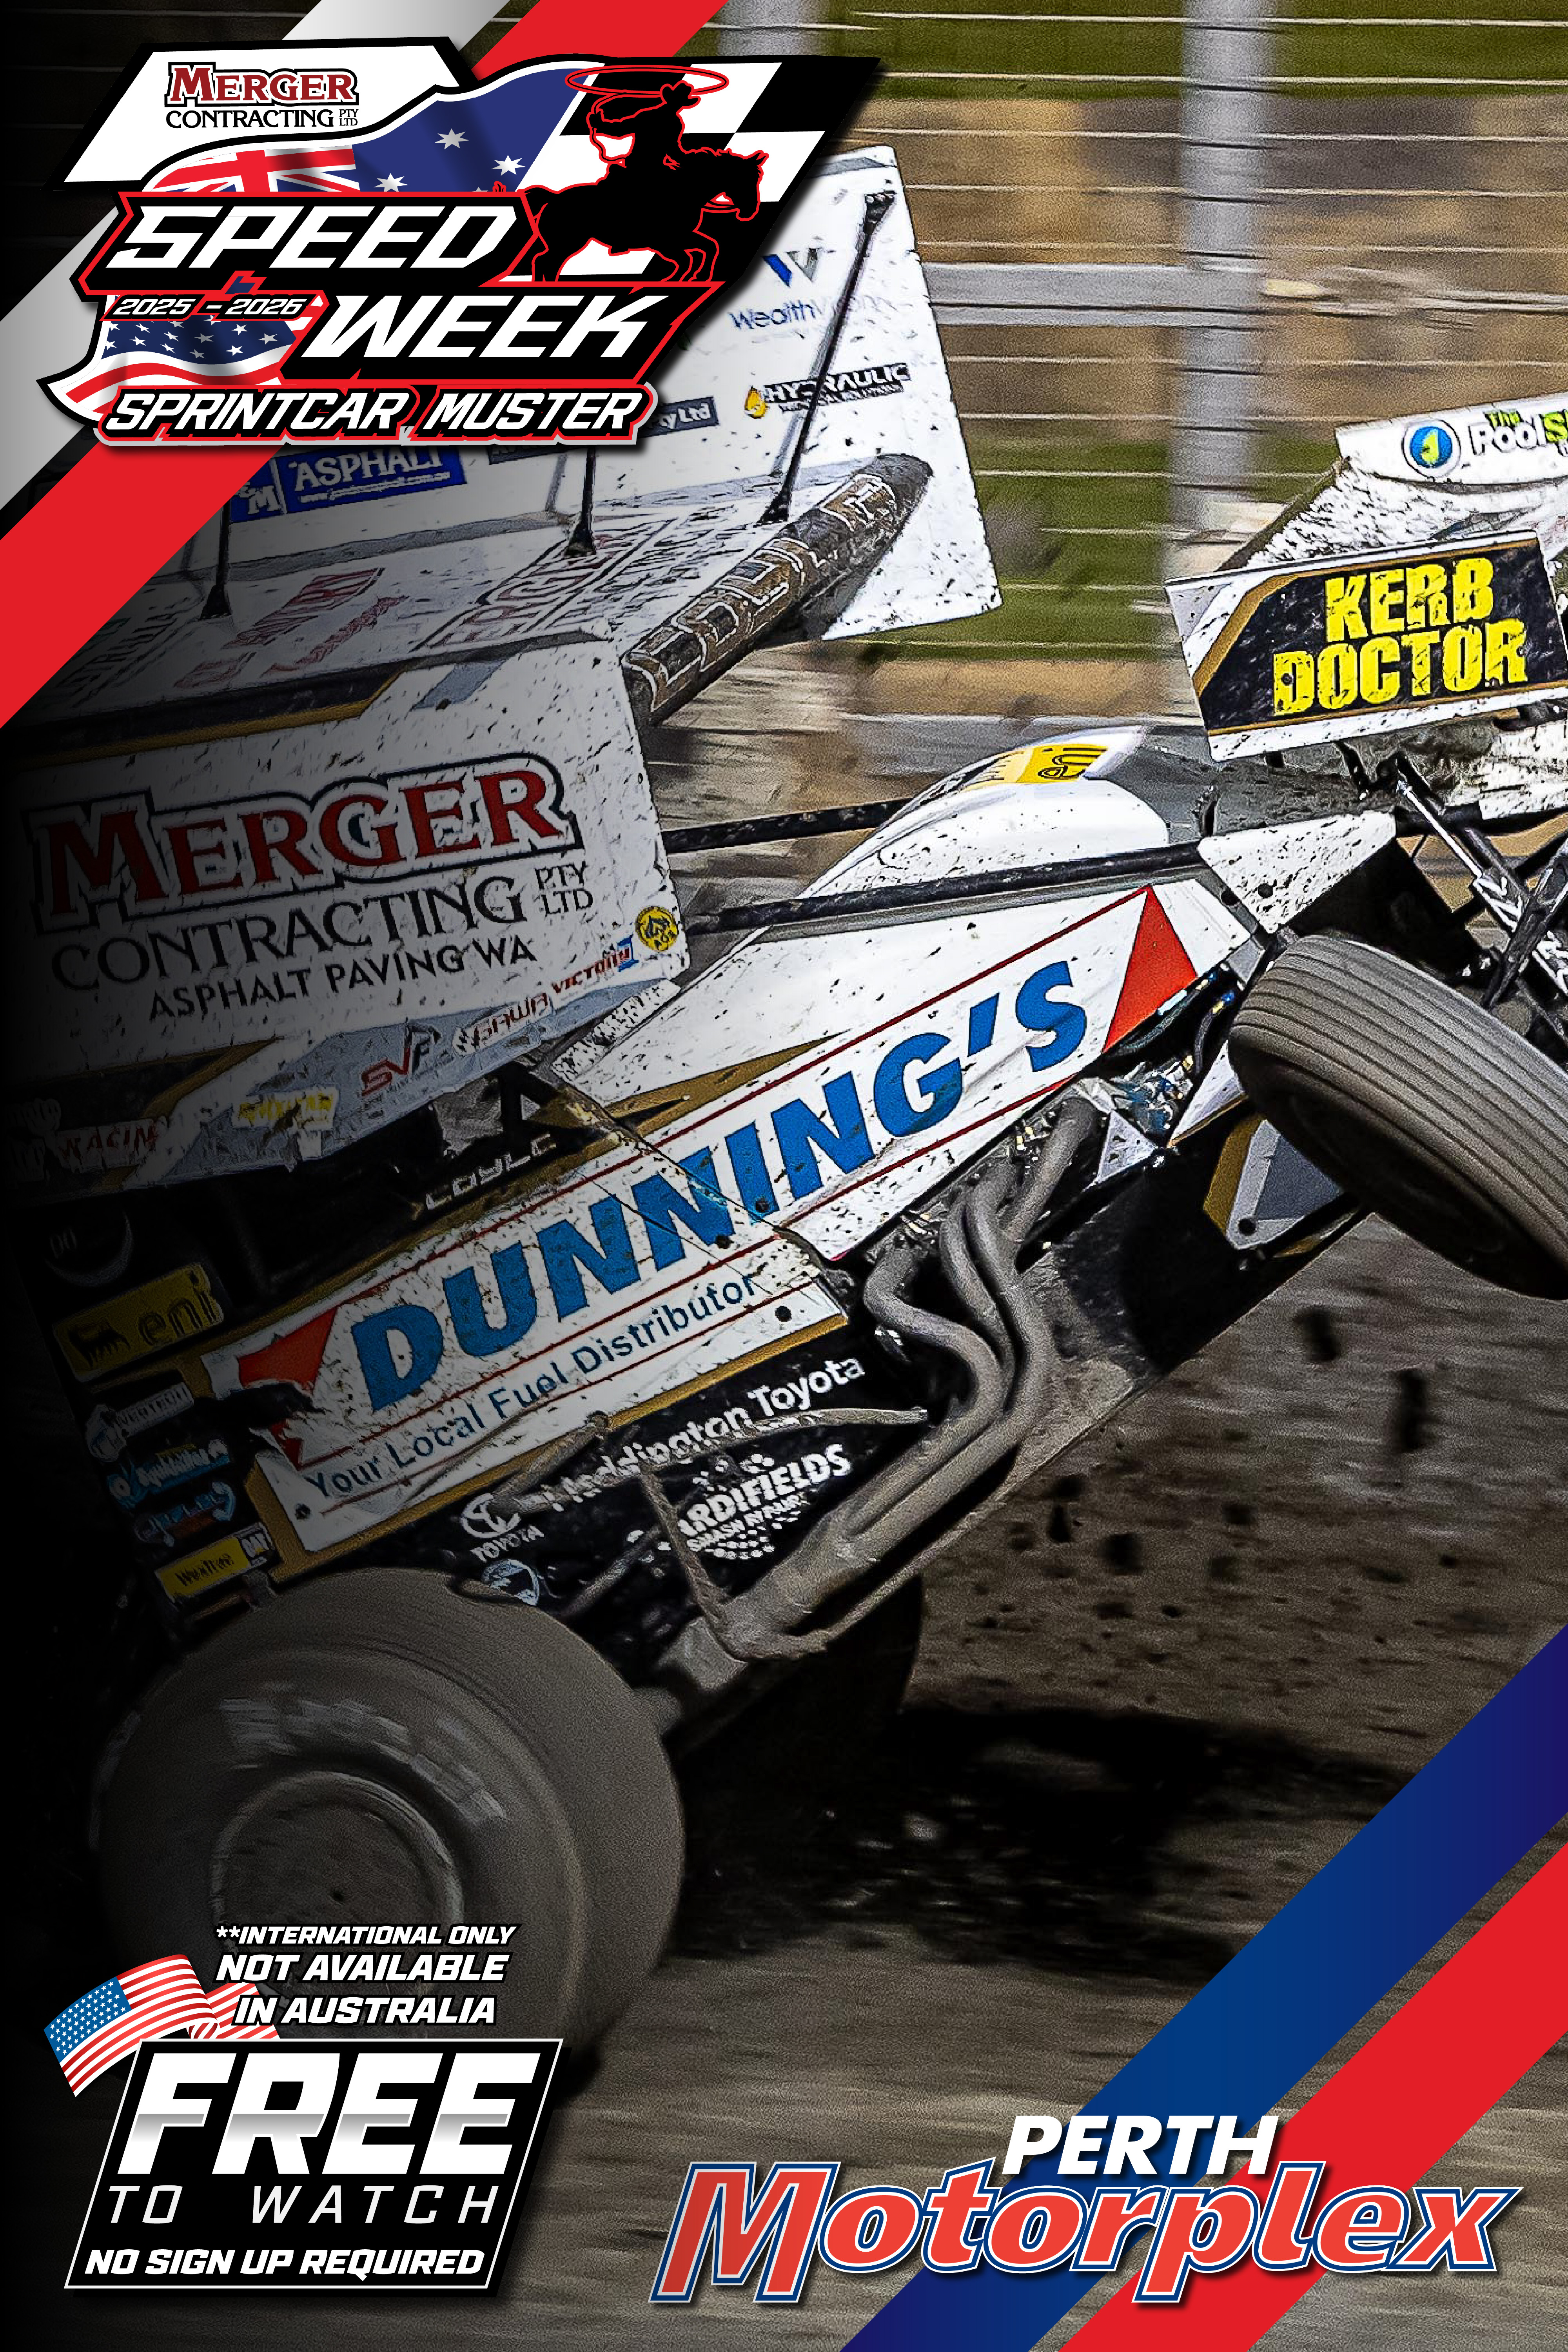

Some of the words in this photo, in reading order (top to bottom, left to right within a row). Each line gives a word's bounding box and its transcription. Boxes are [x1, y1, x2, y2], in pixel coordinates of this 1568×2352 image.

[677, 403, 712, 423] Ltd
[1467, 409, 1568, 456] PoolS
[1324, 557, 1494, 642] KERB
[1273, 617, 1528, 715] DOCTOR
[39, 765, 569, 920] MERGER
[51, 875, 528, 991] CONTRACTING
[534, 861, 588, 891] PTY
[540, 887, 593, 917] LTD
[150, 967, 310, 1021] ASPHALT
[326, 944, 466, 993] PAVING
[472, 935, 537, 969] WA
[350, 960, 1087, 1411] DUNNING'S
[305, 1456, 380, 1498] Your
[387, 1403, 486, 1468] Local
[488, 1364, 568, 1419] Fuel
[572, 1272, 757, 1376] Distributor
[748, 1357, 866, 1416] Toyota
